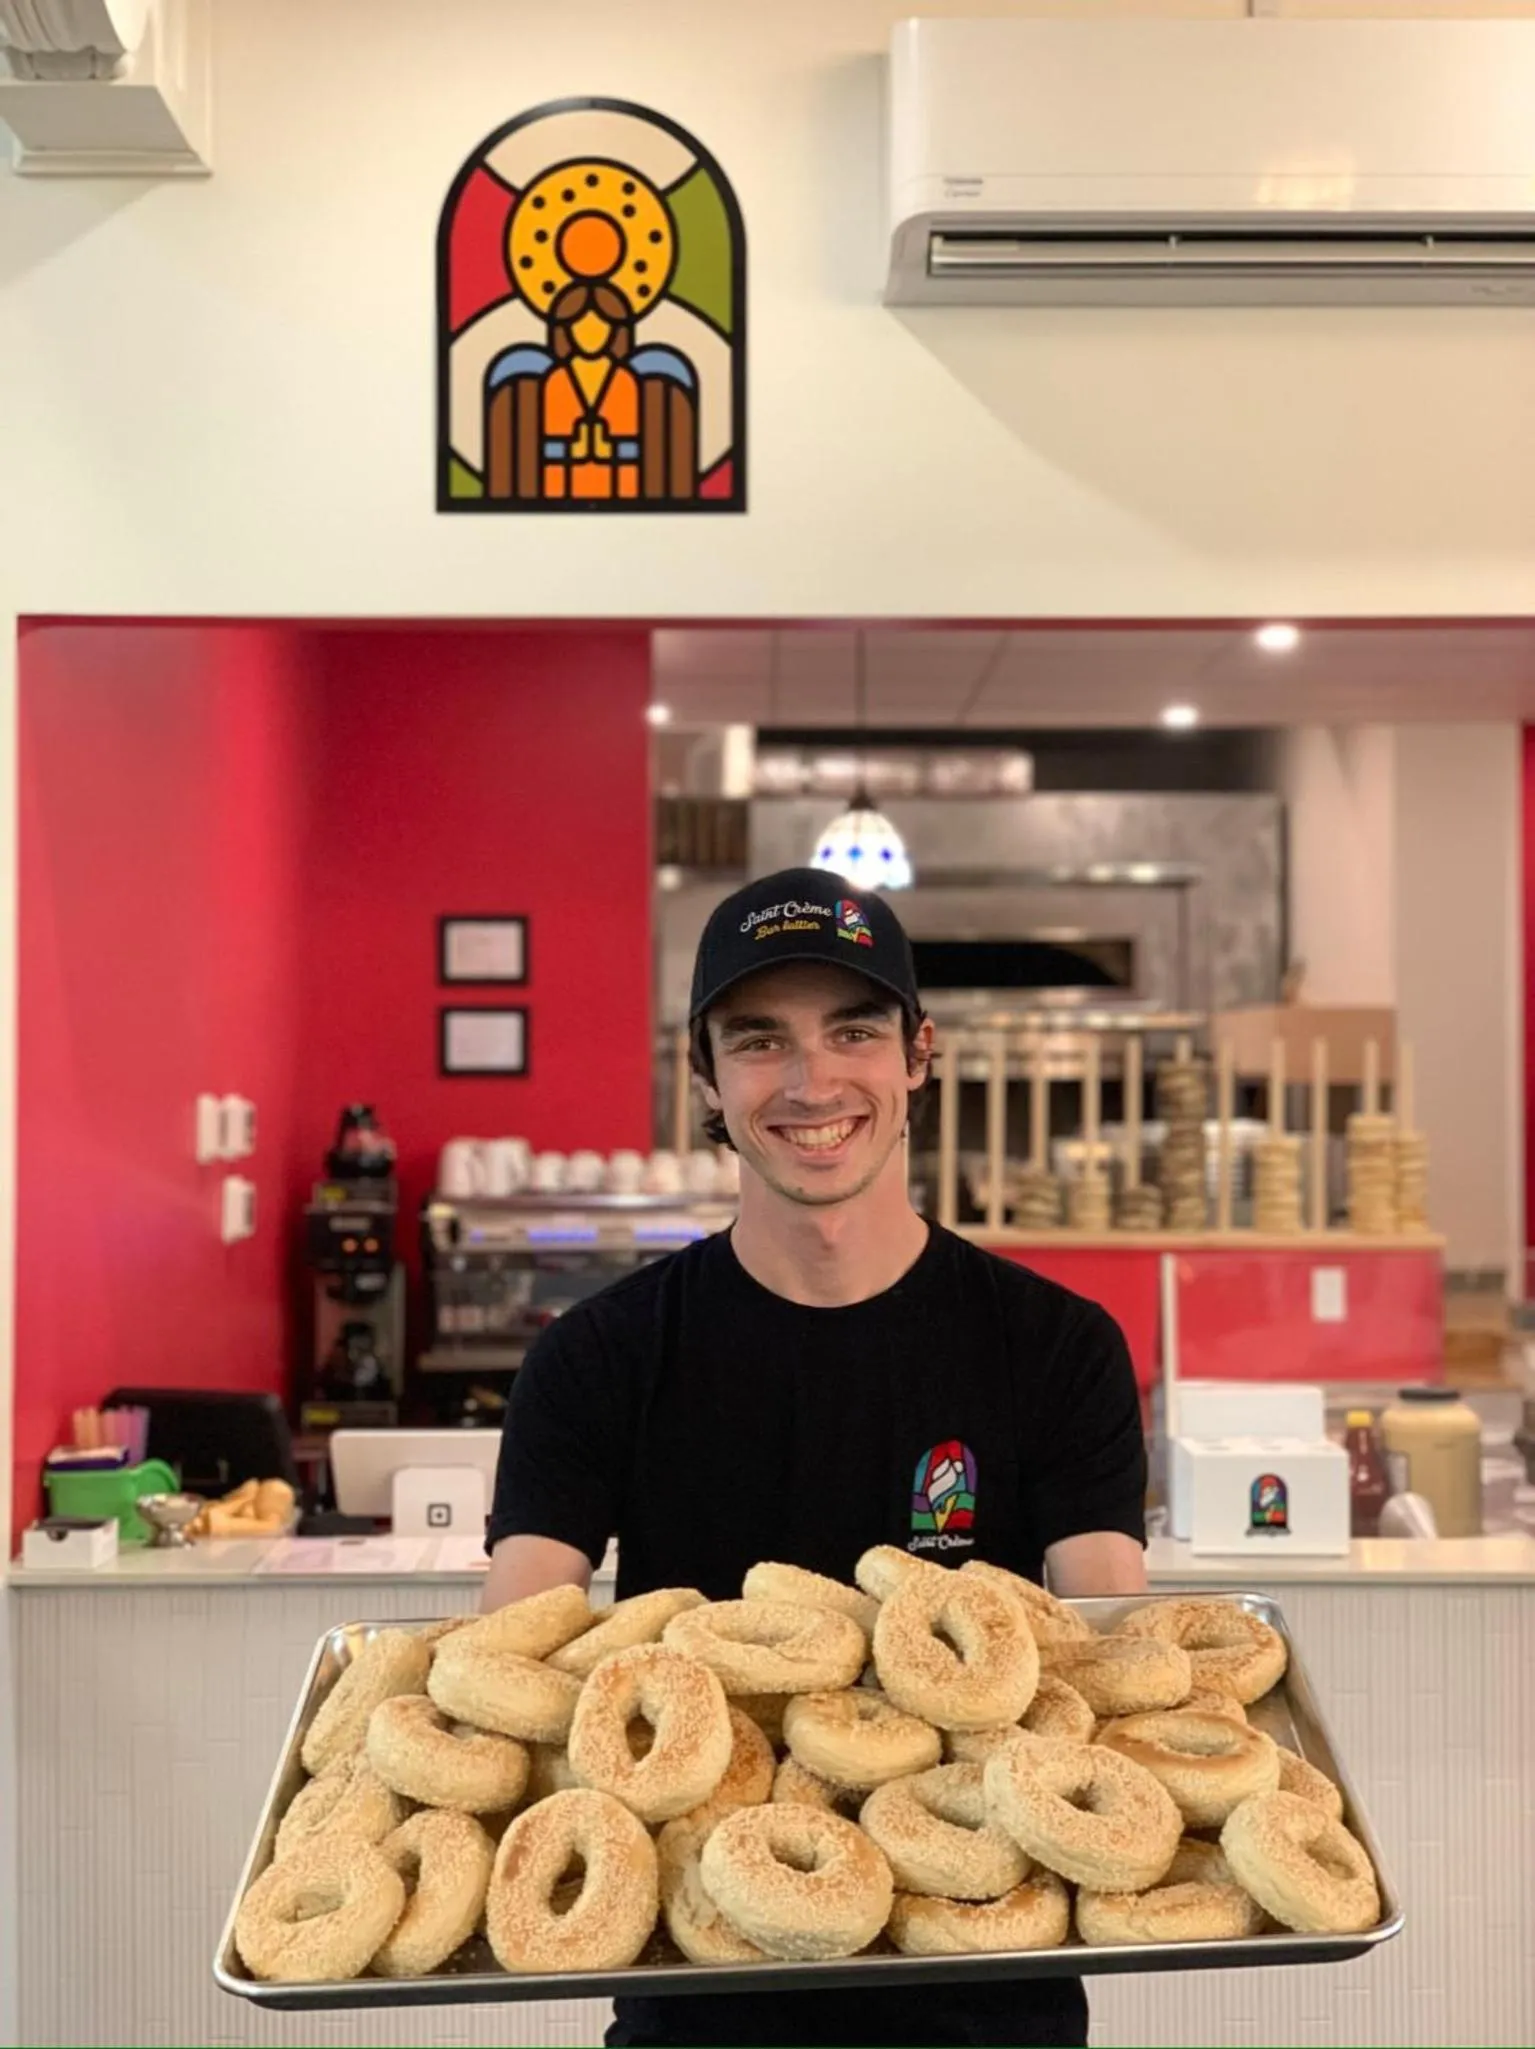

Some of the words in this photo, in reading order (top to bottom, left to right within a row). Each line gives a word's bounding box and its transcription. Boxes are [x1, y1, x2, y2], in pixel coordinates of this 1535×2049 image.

[740, 904, 782, 933] Saint
[783, 900, 833, 918] Crème
[754, 924, 781, 940] Bar
